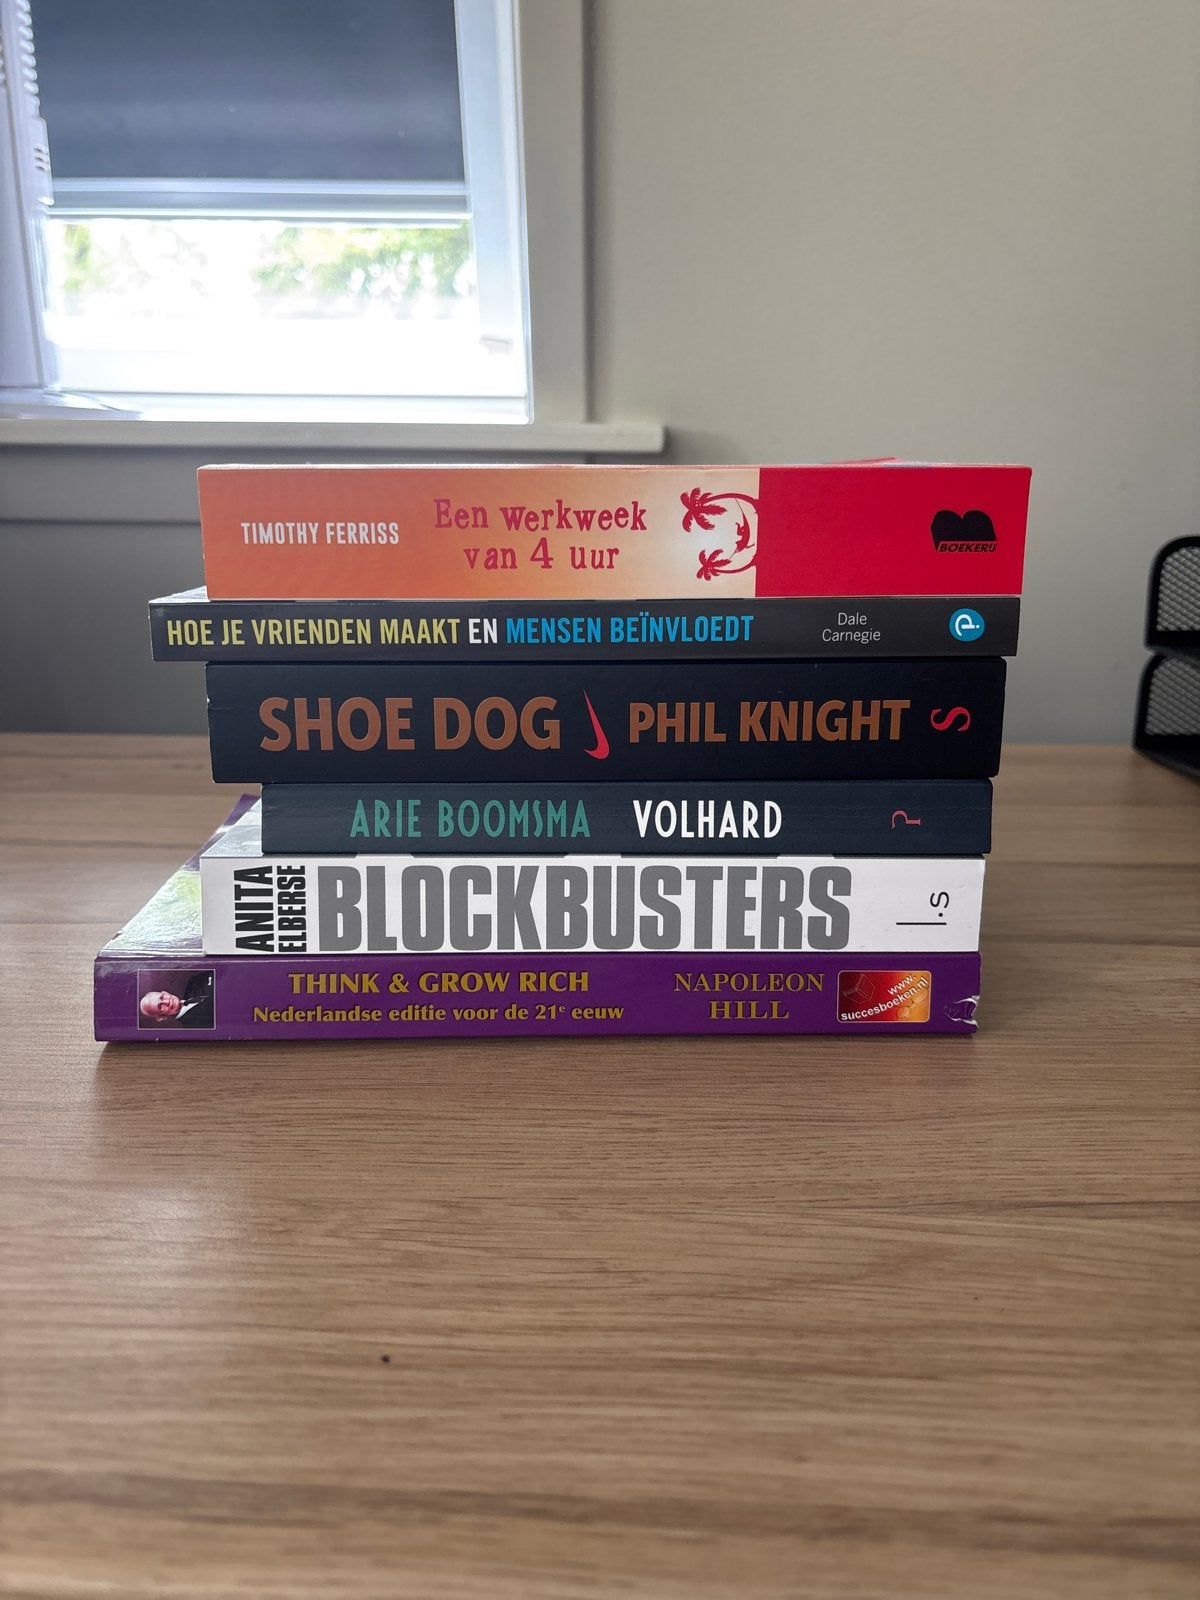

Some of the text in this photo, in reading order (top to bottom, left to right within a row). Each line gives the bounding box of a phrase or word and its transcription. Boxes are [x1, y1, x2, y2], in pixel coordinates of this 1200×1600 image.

[434, 498, 647, 532] Een werkweek
[241, 522, 400, 544] TIMOTHY FERRISS
[463, 537, 620, 570] van 4 uur
[167, 611, 754, 646] HOE JE VRIENDEN MAAKT EN MENSEN BEÏNVLOEDT
[837, 612, 867, 626] Dale
[821, 628, 881, 645] Carnegie
[259, 696, 561, 751] SHOE DOG
[629, 700, 911, 743] PHIL KNIGHT
[350, 800, 591, 838] ARIE BOOMSMA
[633, 800, 782, 839] VOLHARD
[233, 865, 275, 952] ANITA
[277, 865, 307, 952] ELBERSE
[317, 865, 852, 951] BLOCKBUSTERS
[289, 971, 589, 994] THINK & GROW RICH
[673, 972, 824, 992] NAPOLEON
[841, 976, 929, 1021] succesboeken.nl
[253, 1006, 382, 1024] Nederlandse
[388, 1005, 446, 1022] editie
[452, 1005, 498, 1022] voor
[504, 1003, 529, 1020] de
[571, 1007, 624, 1020] eeuw
[709, 1000, 790, 1020] HILL
